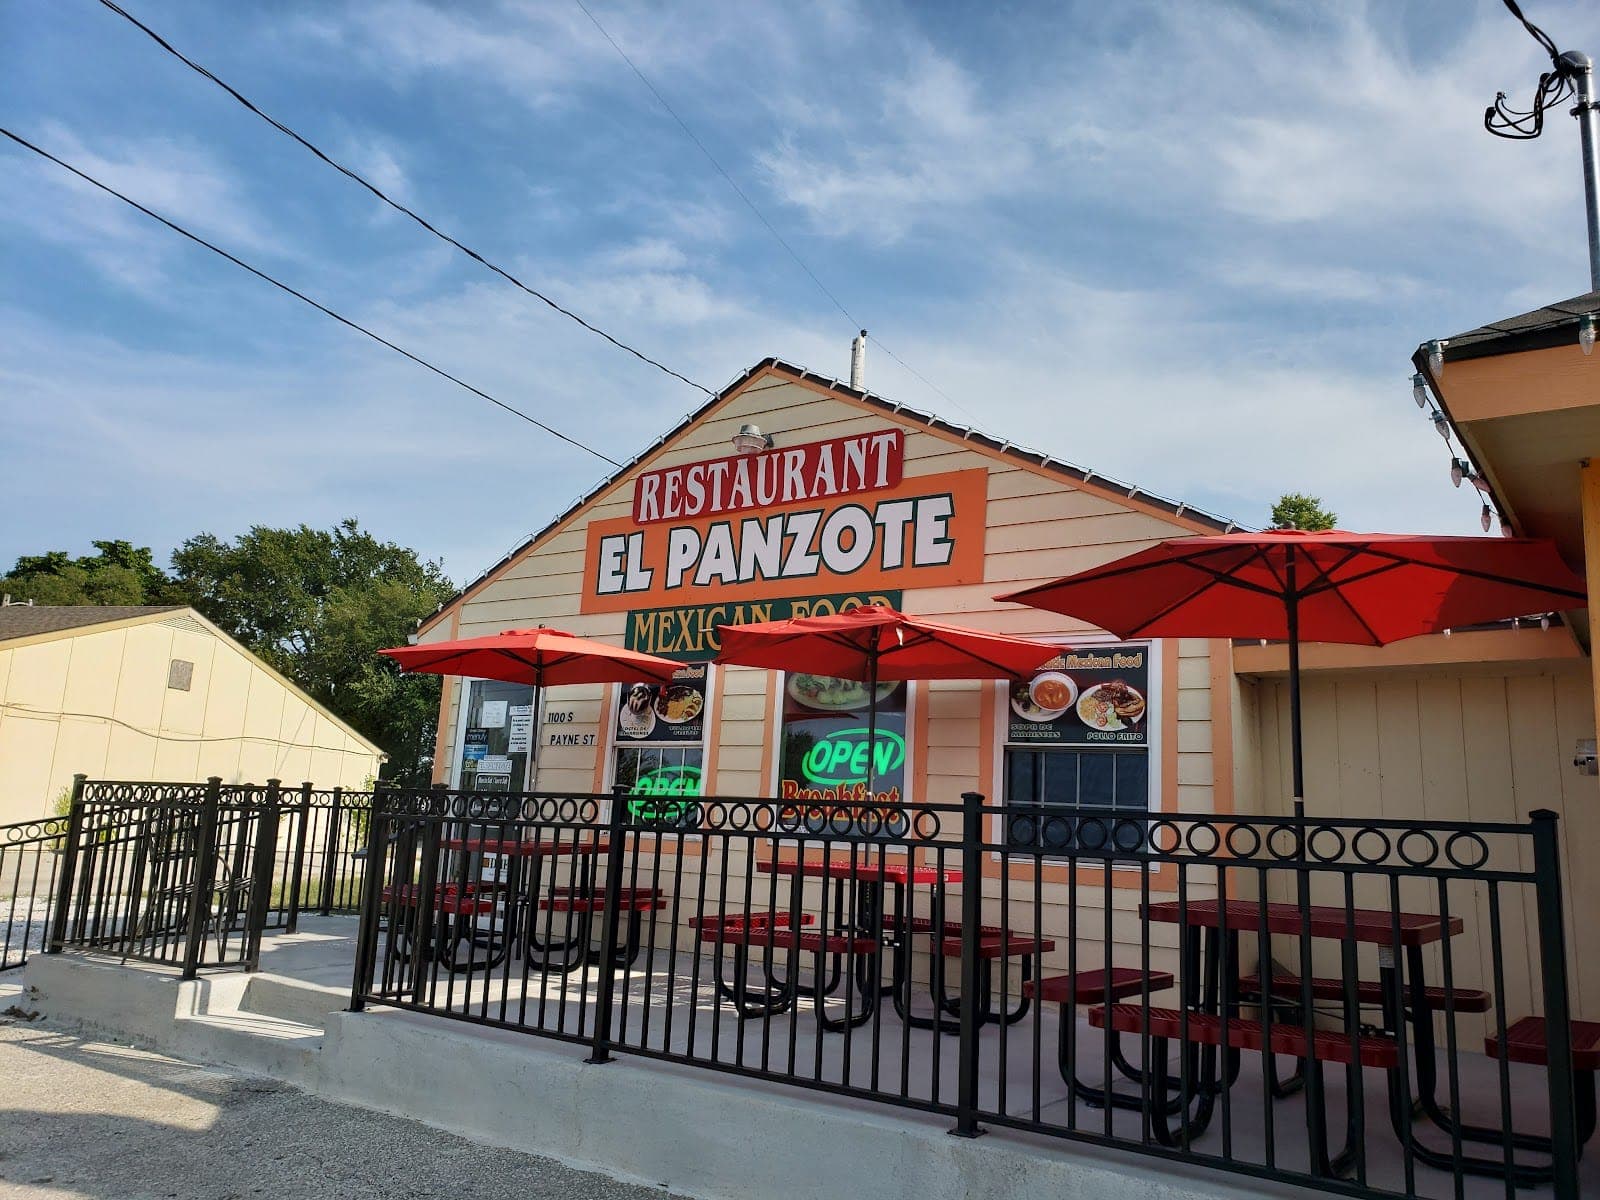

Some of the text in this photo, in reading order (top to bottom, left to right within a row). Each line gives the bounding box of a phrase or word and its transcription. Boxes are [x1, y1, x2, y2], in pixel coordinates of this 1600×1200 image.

[638, 432, 898, 524] RESTAURANT
[597, 493, 955, 595] EL PANZOTE
[1066, 654, 1111, 669] Mexican
[1113, 652, 1143, 668] Food
[548, 711, 574, 723] 1100 S
[550, 734, 596, 745] PAYNE ST
[1087, 731, 1144, 741] POLLO FRITO
[808, 739, 896, 777] OPEN
